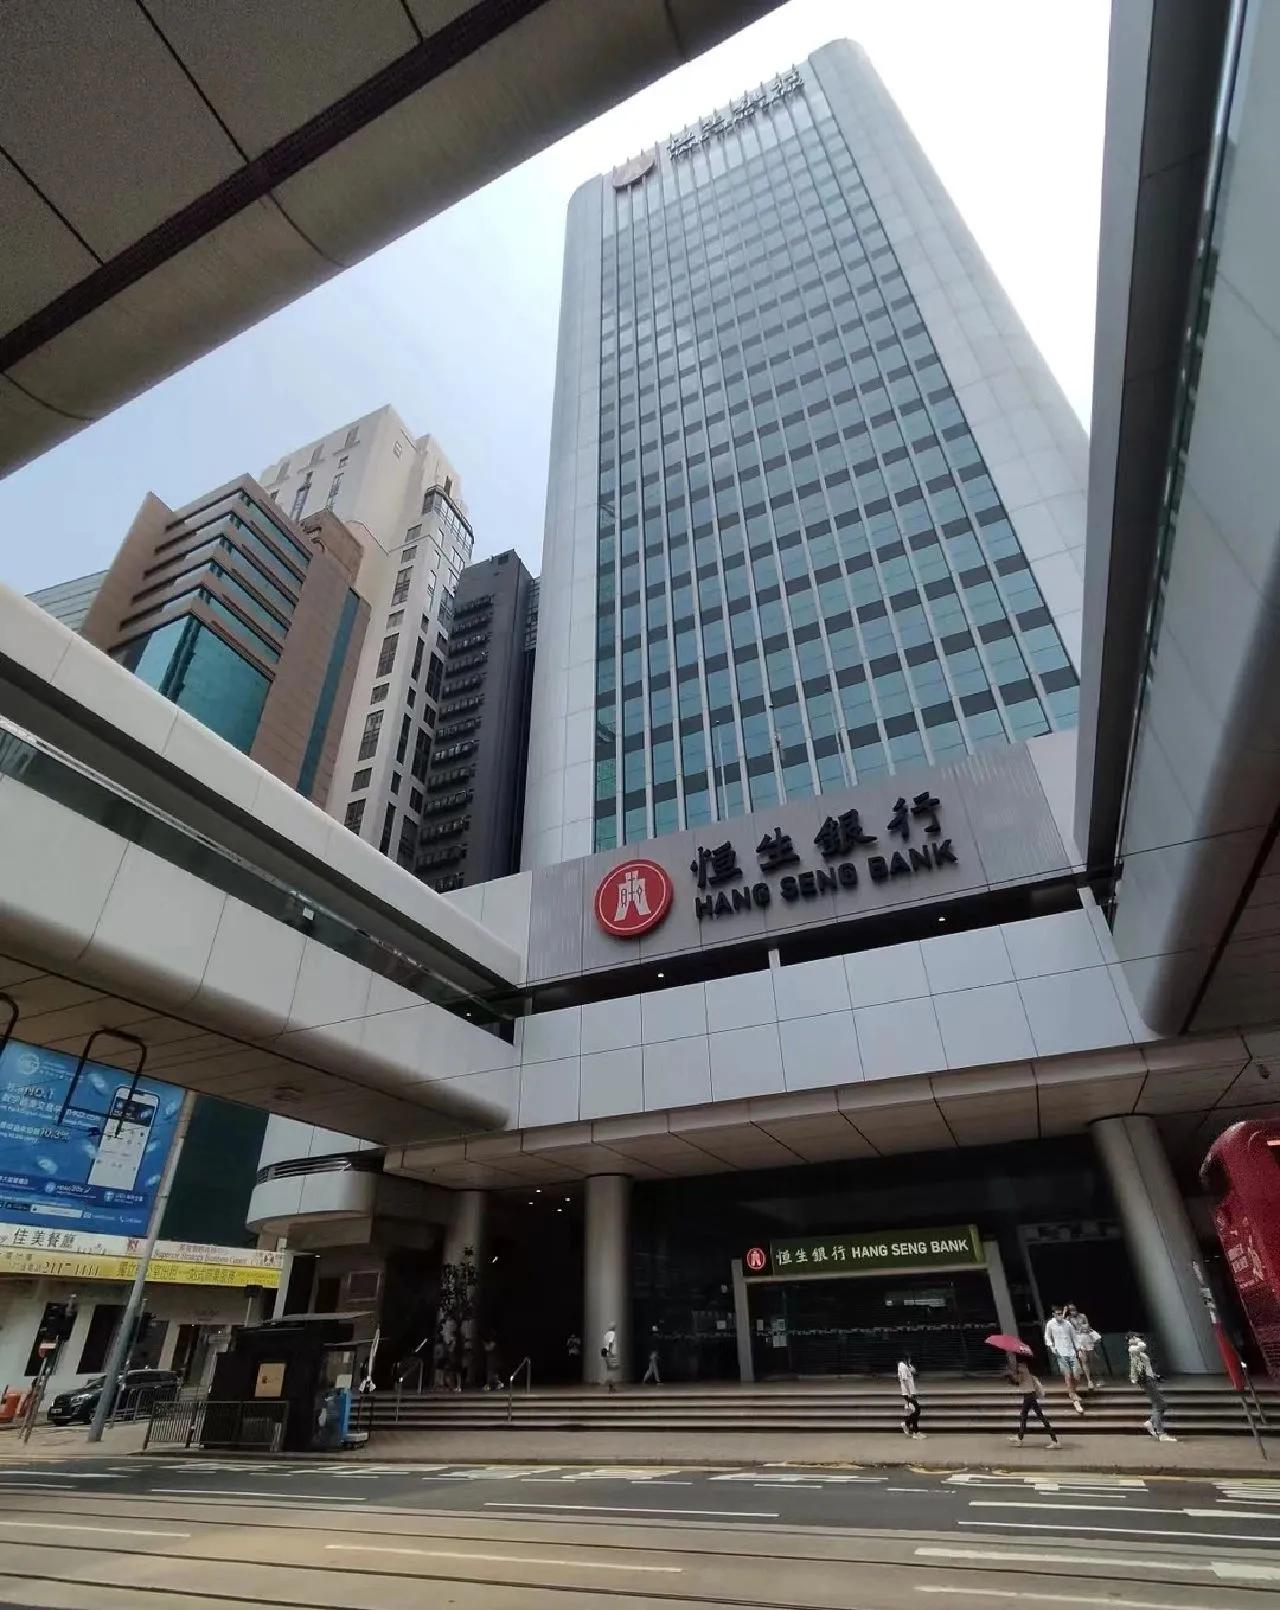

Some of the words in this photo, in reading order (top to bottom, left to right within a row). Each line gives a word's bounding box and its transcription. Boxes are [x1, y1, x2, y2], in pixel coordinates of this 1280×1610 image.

[690, 792, 942, 888] 恒生銀行
[695, 883, 771, 918] HANG
[780, 863, 858, 902] SENG
[868, 839, 959, 882] BANK
[13, 1228, 77, 1249] 佳美餐廳
[776, 1245, 845, 1265] 恒生銀行
[851, 1244, 888, 1258] HANG
[892, 1242, 927, 1256] SENG
[931, 1239, 968, 1253] BANK
